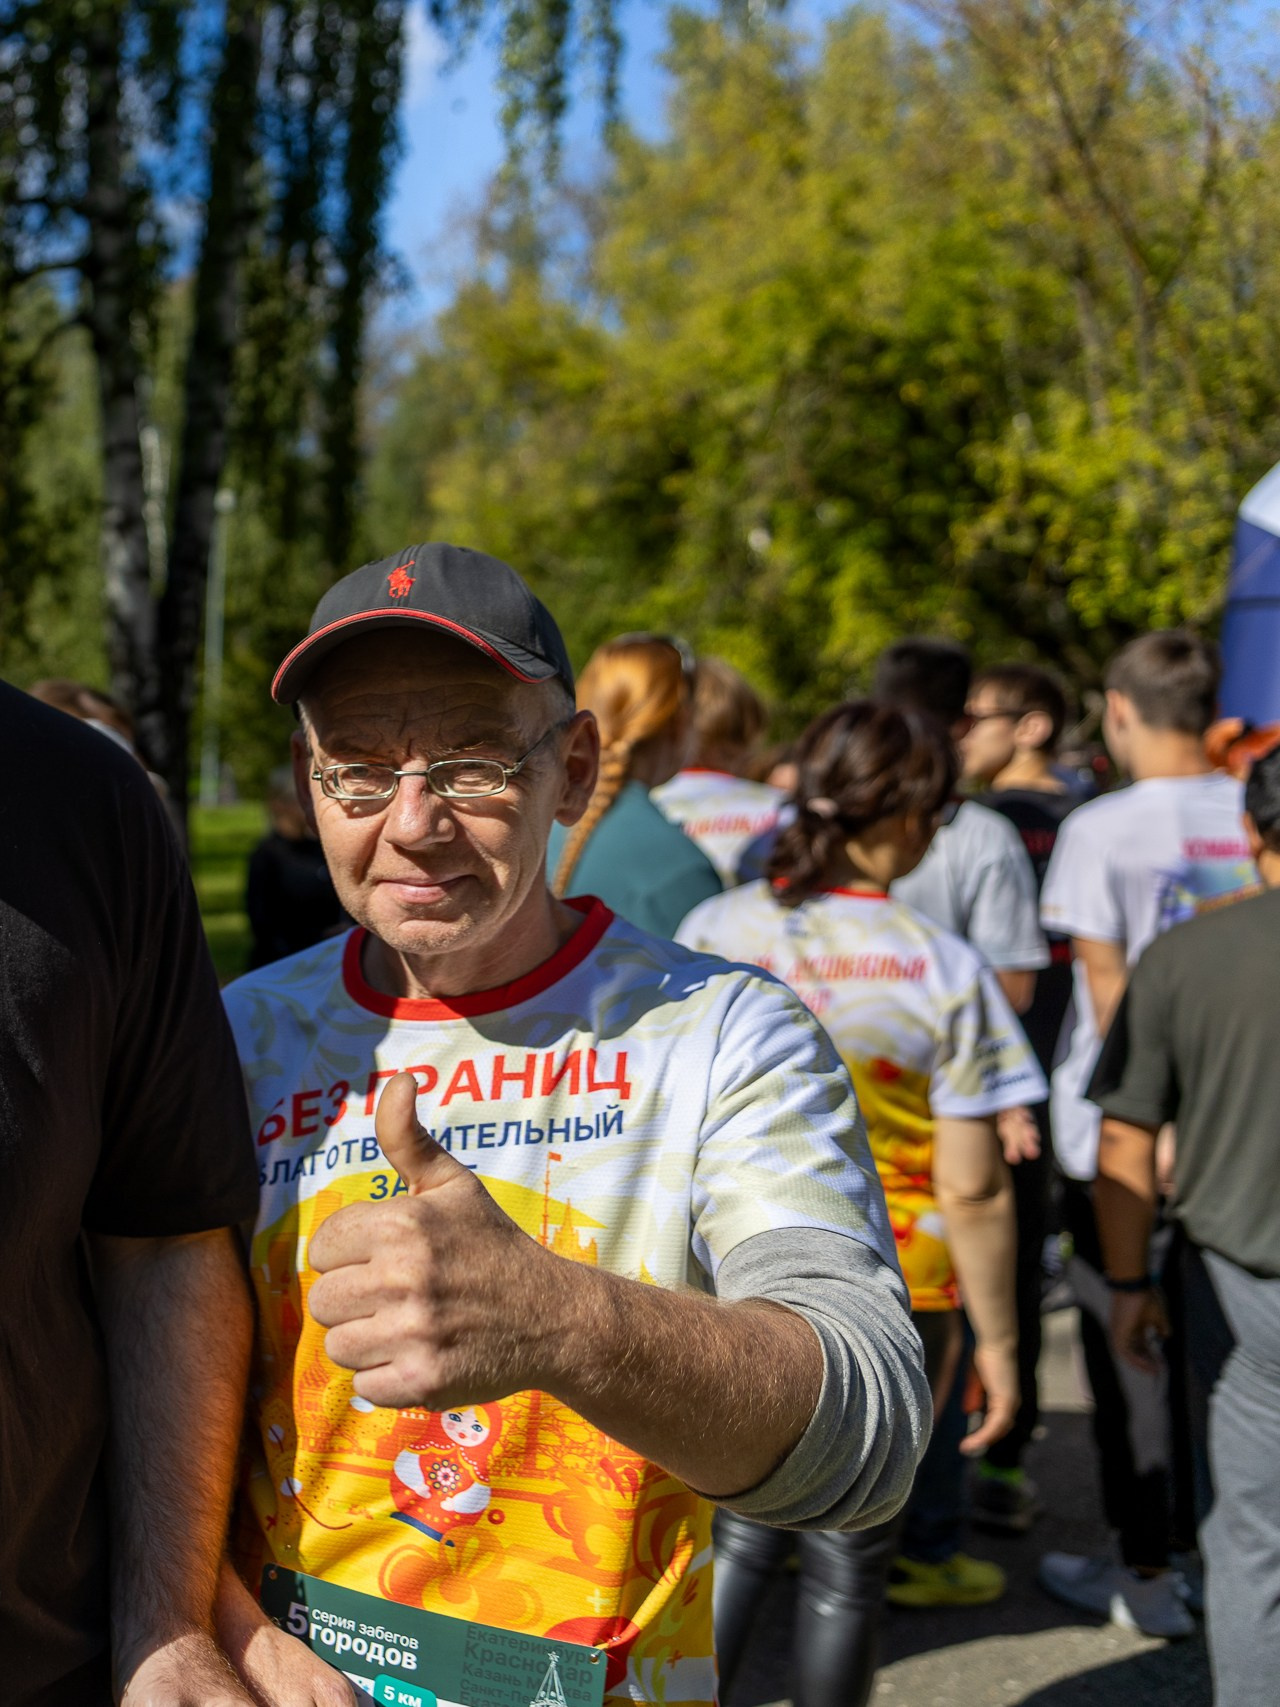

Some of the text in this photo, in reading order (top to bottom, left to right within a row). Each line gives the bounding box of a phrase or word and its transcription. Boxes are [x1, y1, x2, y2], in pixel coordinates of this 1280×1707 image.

[286, 1601, 418, 1670] 5 городов
[311, 1608, 420, 1650] серия забегов
[462, 1662, 524, 1687] Казань
[383, 1685, 395, 1701] 5
